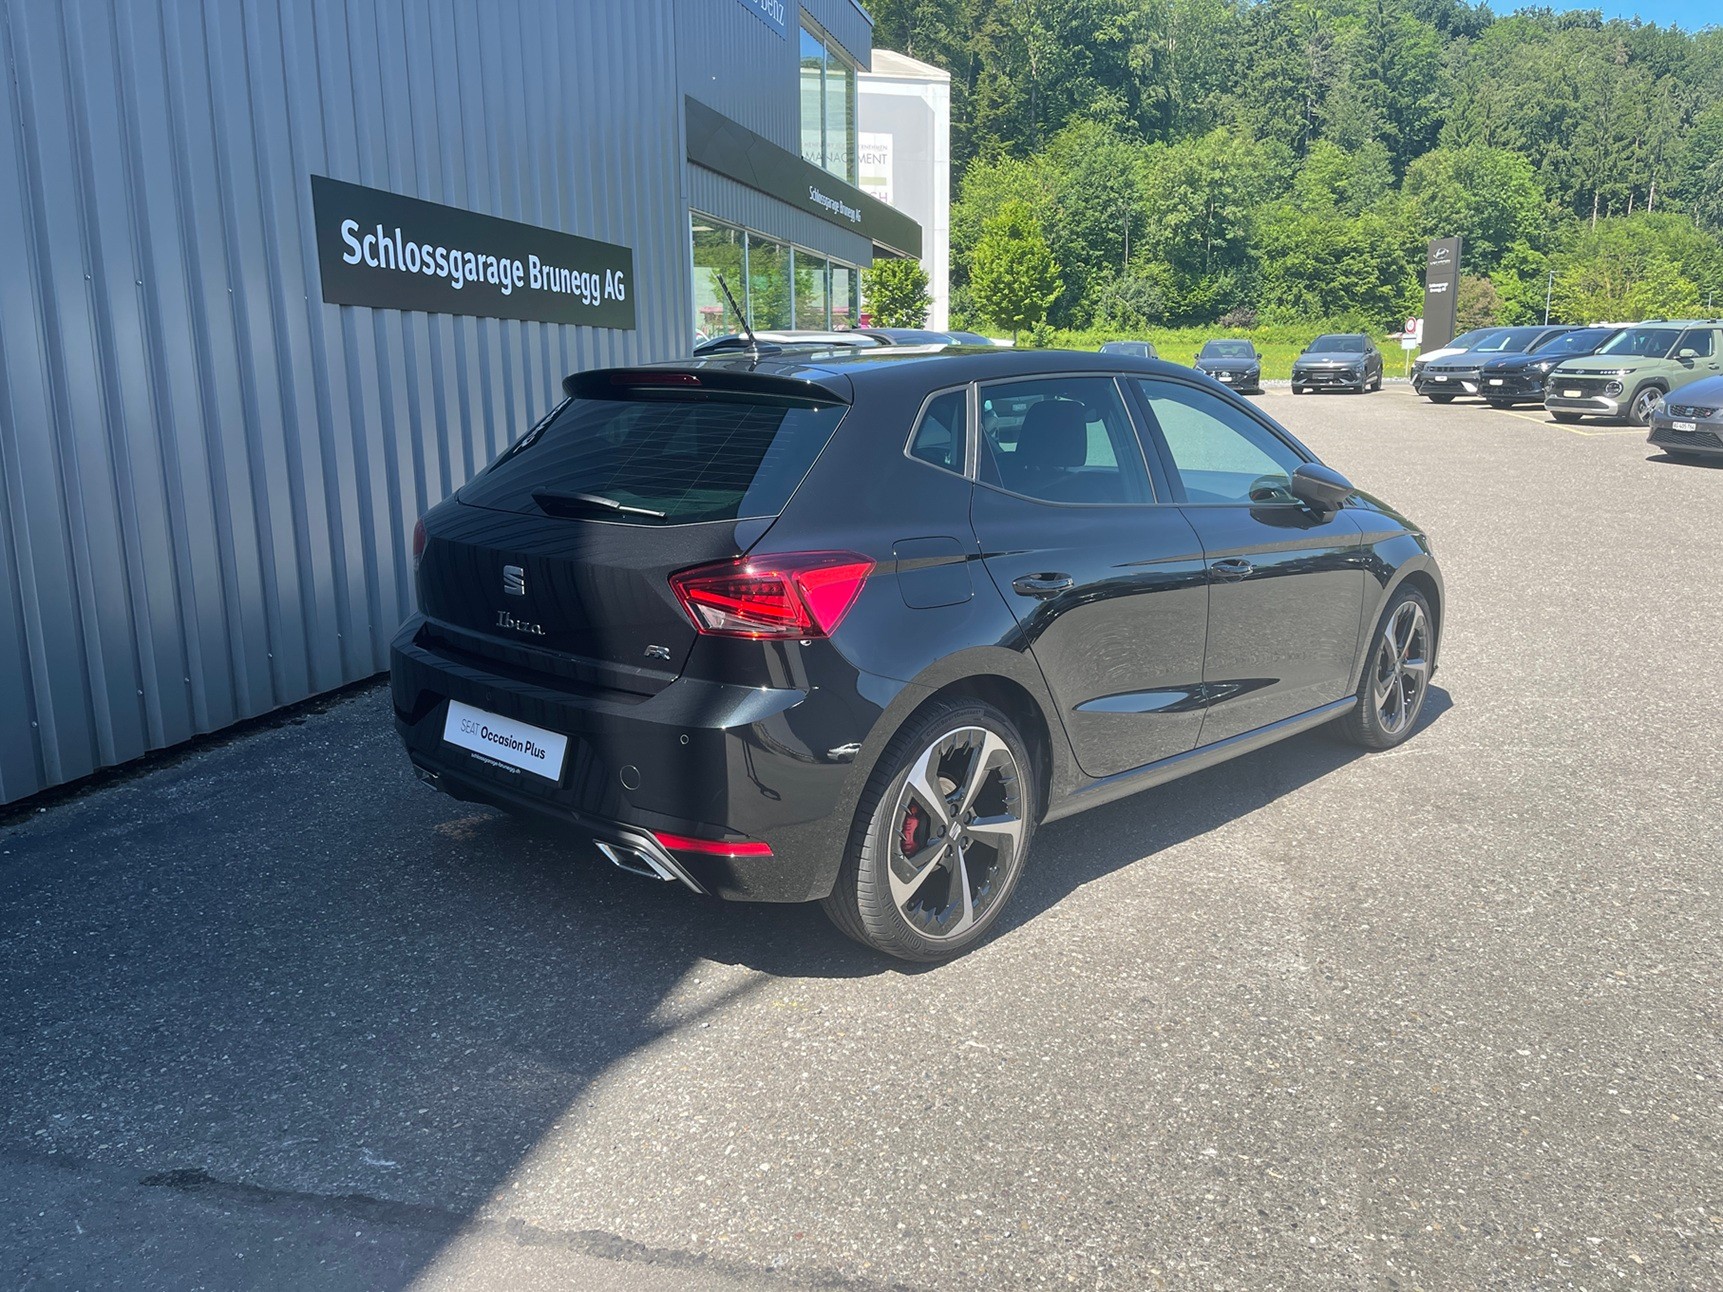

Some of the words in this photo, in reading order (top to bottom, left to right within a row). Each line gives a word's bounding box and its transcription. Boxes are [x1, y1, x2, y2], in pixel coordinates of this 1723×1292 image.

[341, 218, 525, 296] Schlossgarage
[528, 254, 600, 307] Brunegg
[604, 268, 626, 301] AG
[496, 610, 546, 636] Ibiza
[460, 718, 481, 736] SEAT
[480, 726, 523, 752] Occasion
[524, 740, 546, 760] Plus
